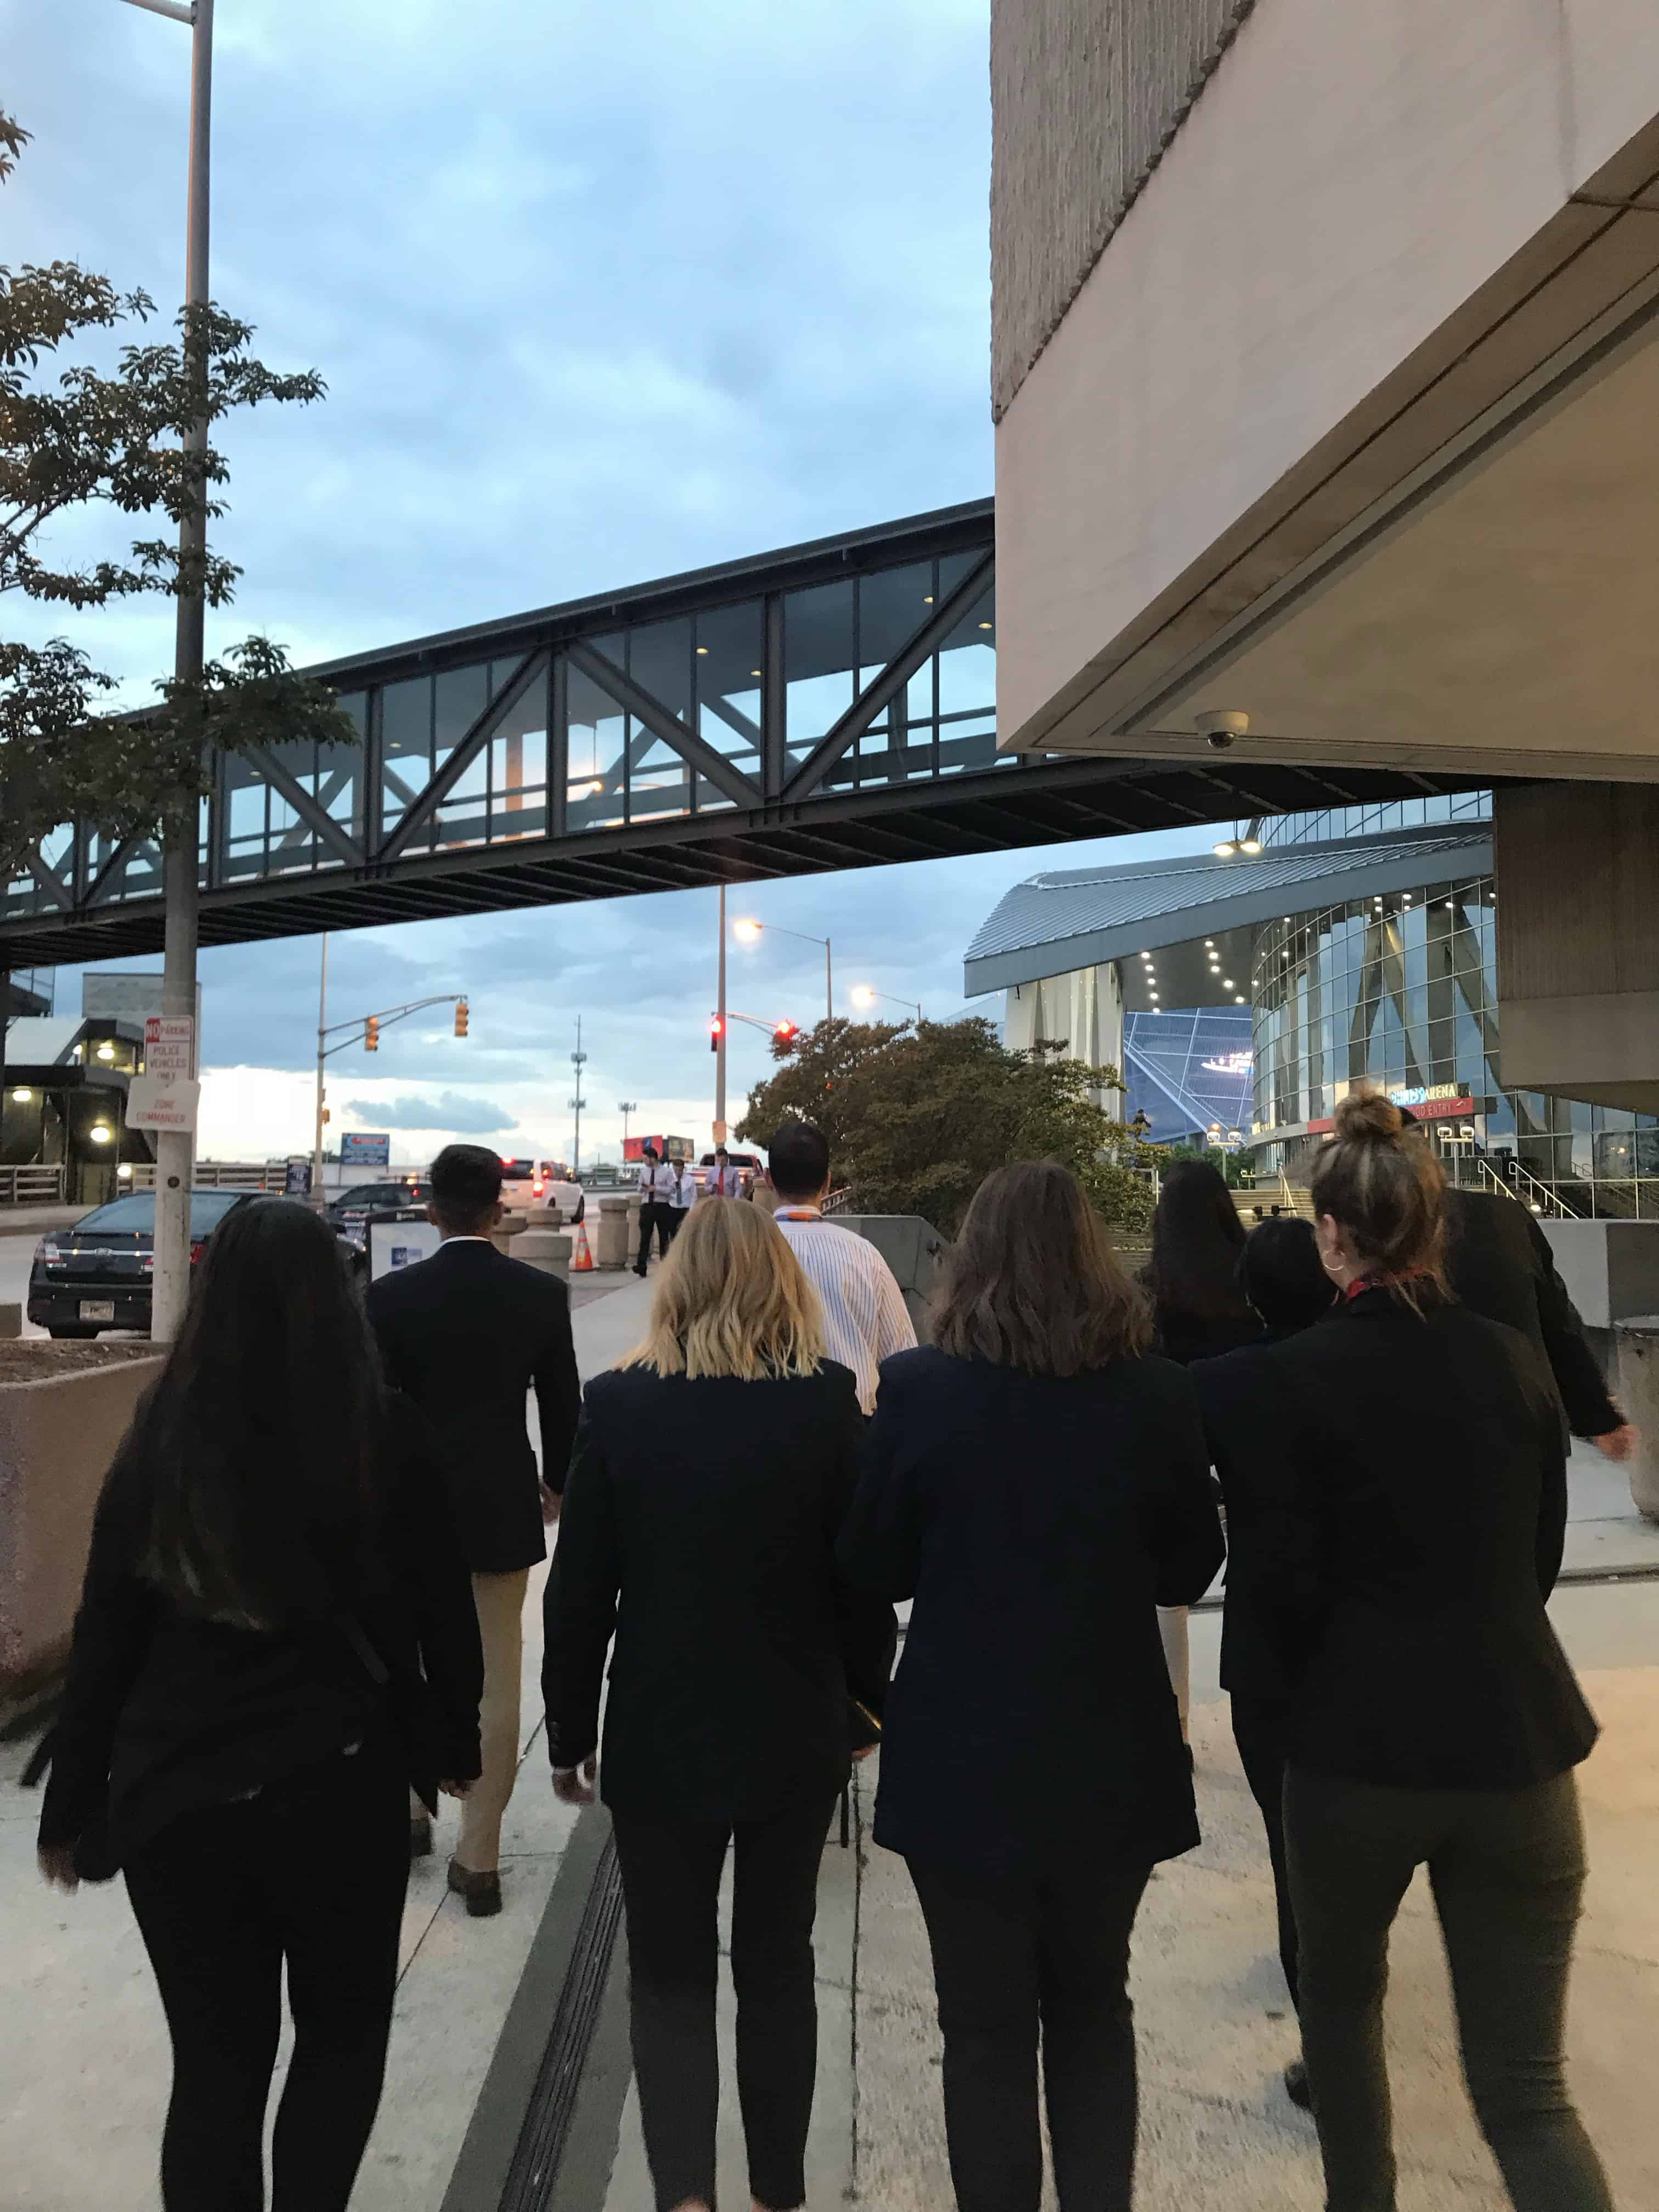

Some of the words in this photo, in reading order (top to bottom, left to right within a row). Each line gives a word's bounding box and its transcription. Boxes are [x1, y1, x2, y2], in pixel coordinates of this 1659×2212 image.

[146, 1023, 159, 1037] NO
[161, 1026, 189, 1035] PARKING
[153, 1045, 180, 1055] POLICE
[150, 1058, 187, 1068] VEHICLES
[1425, 1084, 1456, 1100] ARENA
[154, 1099, 176, 1110] ZONE
[1428, 1103, 1451, 1116] ENTRY
[137, 1112, 186, 1123] COMMANDER
